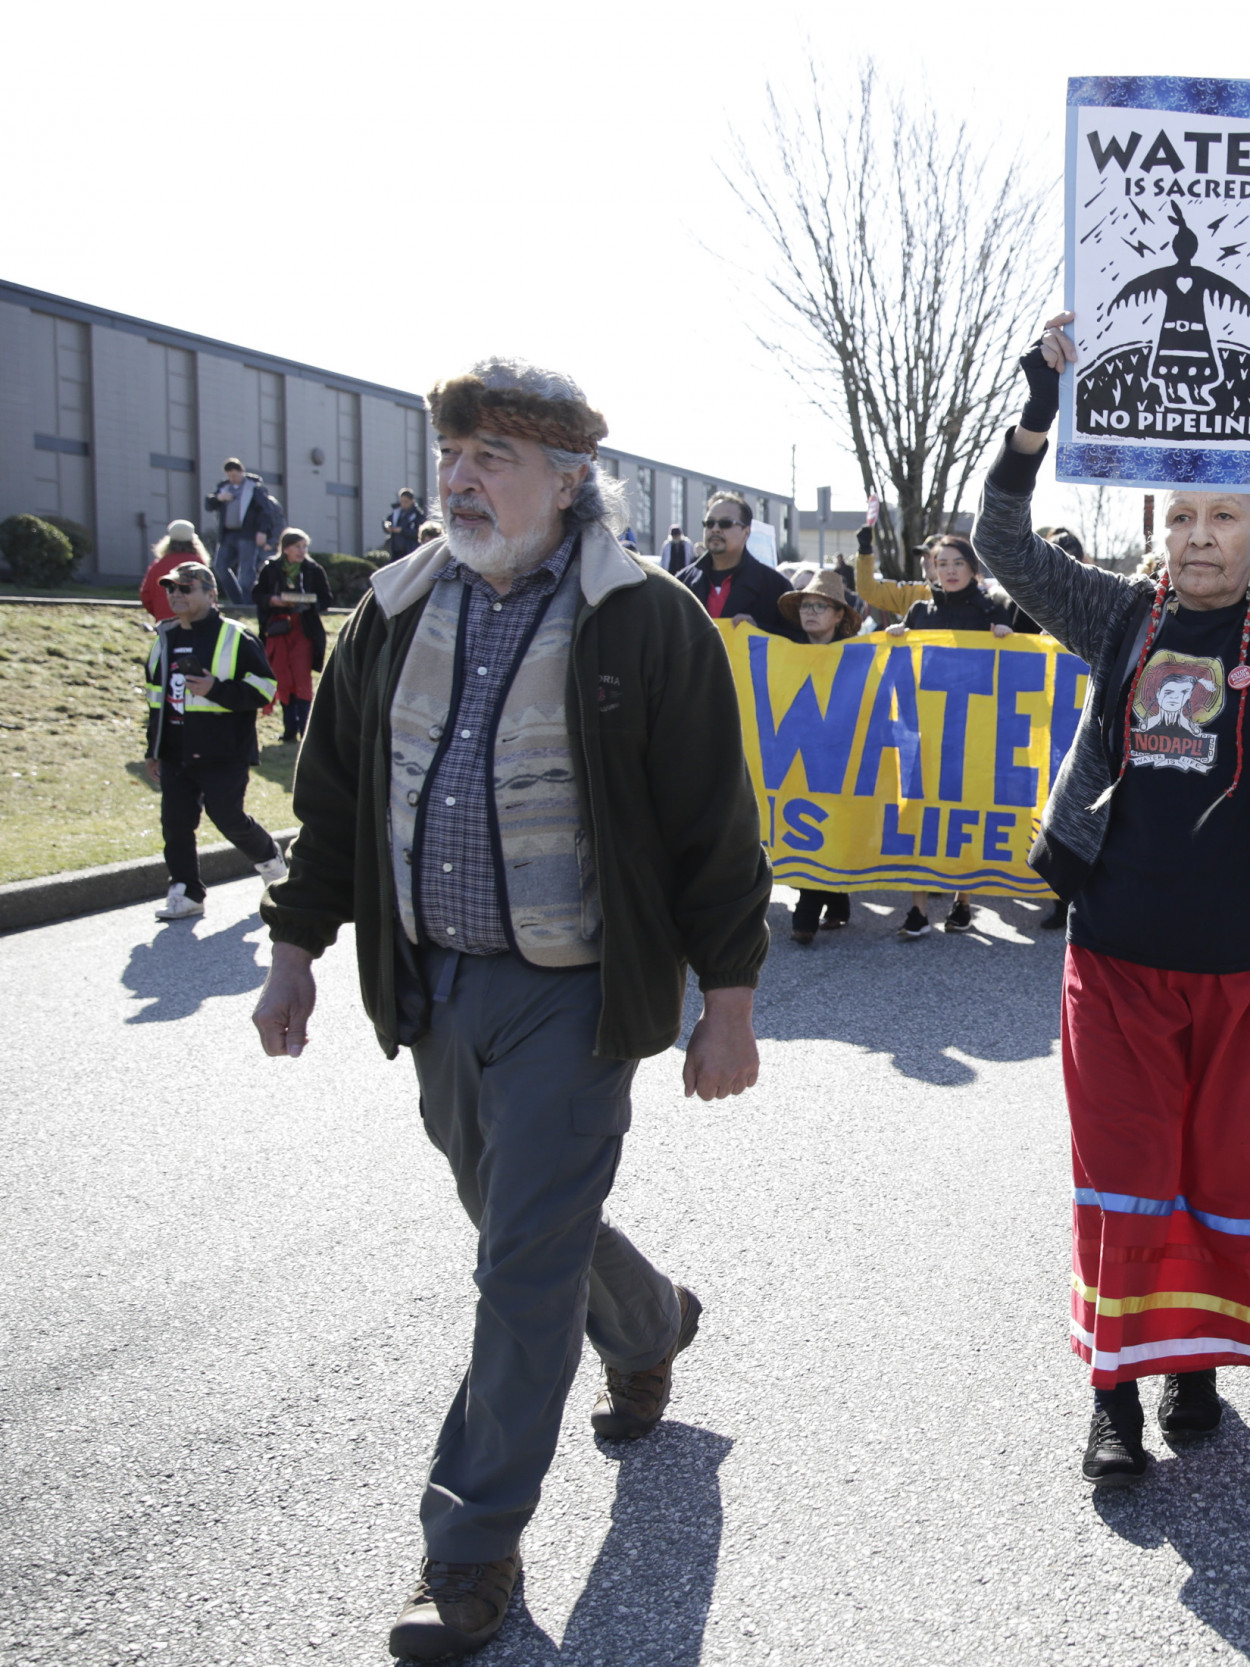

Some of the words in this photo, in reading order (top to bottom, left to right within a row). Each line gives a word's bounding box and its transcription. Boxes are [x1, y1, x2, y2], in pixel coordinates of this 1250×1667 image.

[1124, 177, 1146, 197] IS
[1089, 409, 1131, 430] NO
[1134, 733, 1203, 757] NODAPL!
[1135, 755, 1164, 764] WATER
[1182, 757, 1203, 769] LIFE
[880, 803, 1017, 862] LIFE
